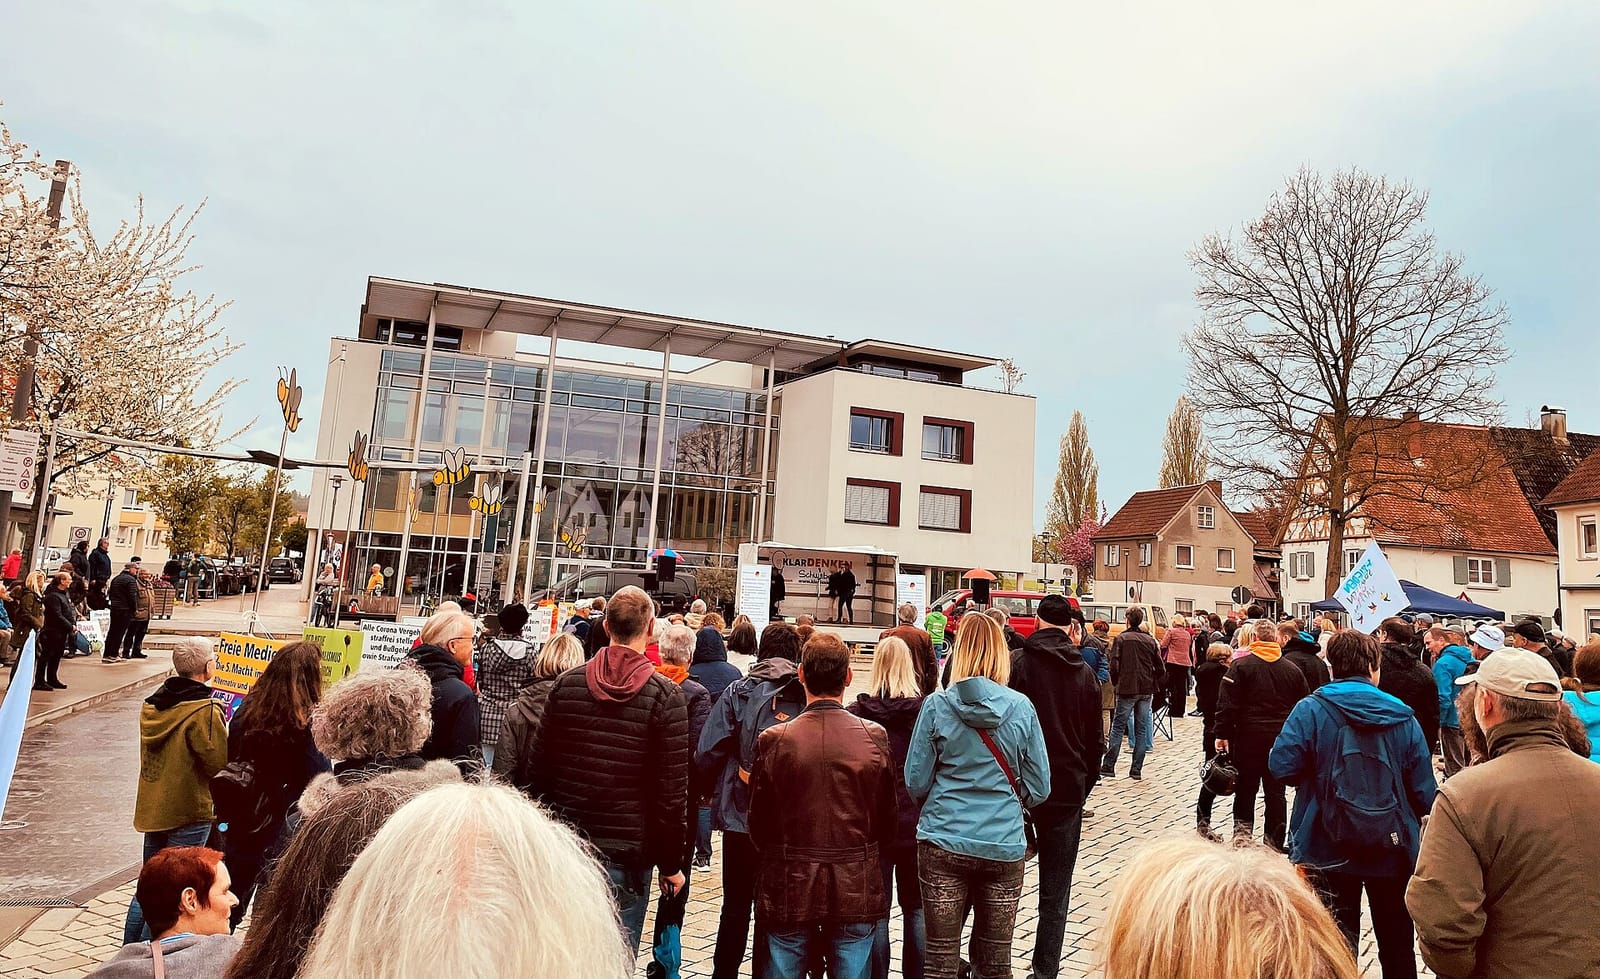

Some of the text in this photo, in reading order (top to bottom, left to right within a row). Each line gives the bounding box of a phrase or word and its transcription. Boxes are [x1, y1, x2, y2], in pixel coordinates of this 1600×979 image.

[362, 623, 376, 632] Alle
[376, 625, 398, 634] Corona
[370, 634, 396, 643] straffrei
[218, 638, 242, 657] Freie
[370, 644, 411, 655] und Bußgeld
[231, 663, 254, 678] Macht
[236, 682, 250, 691] und
